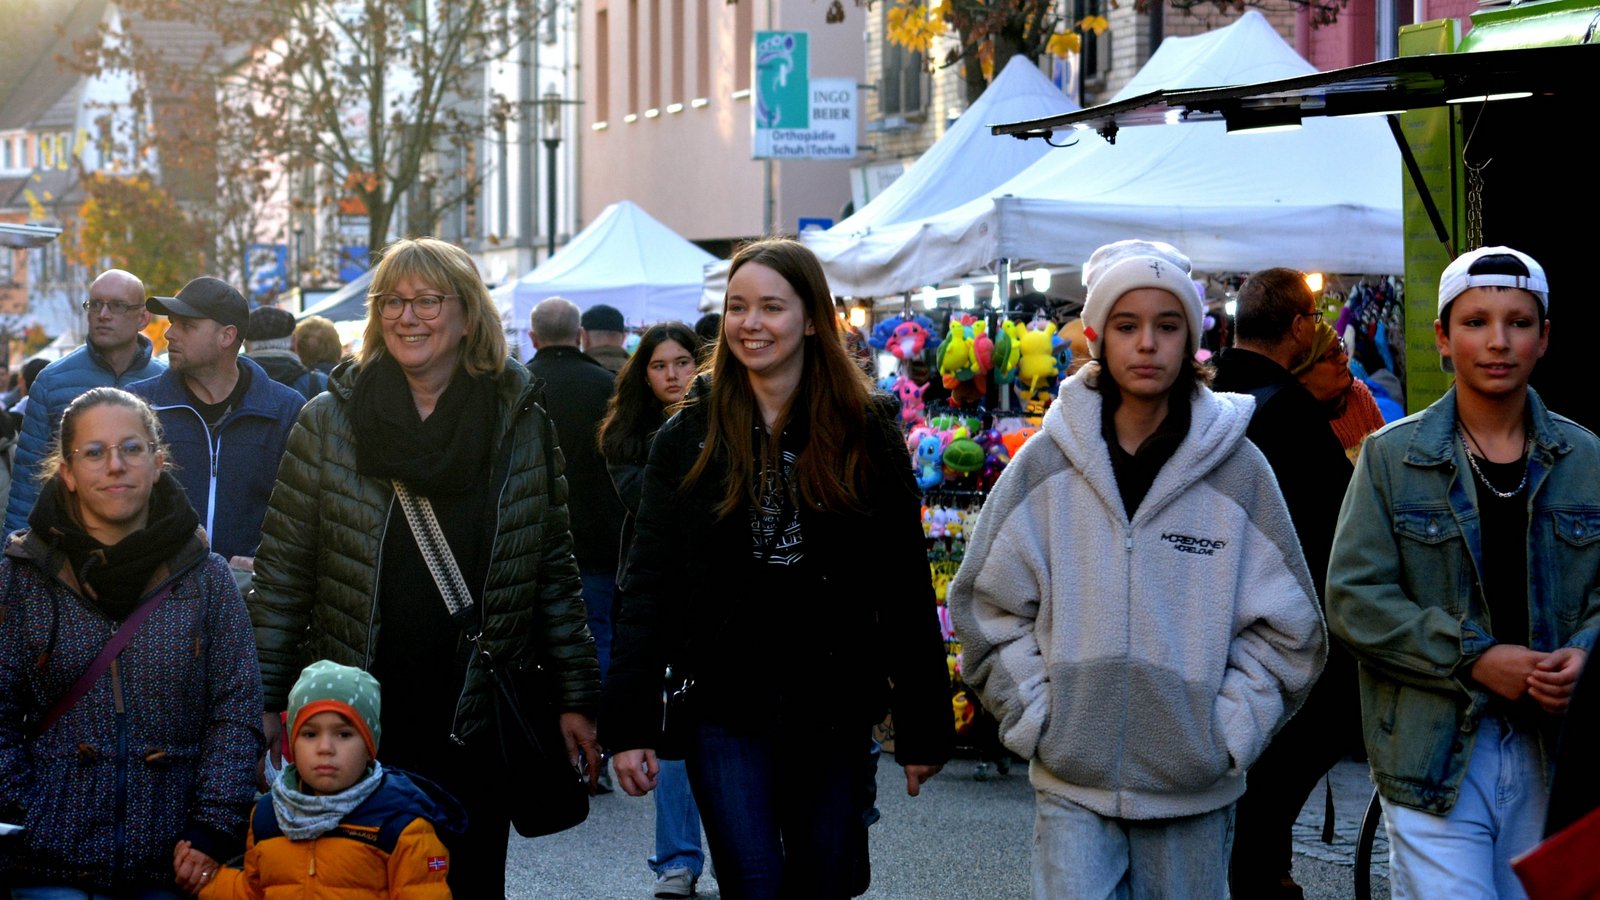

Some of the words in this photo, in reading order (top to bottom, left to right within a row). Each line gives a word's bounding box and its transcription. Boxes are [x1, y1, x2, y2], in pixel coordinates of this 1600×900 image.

[813, 90, 850, 103] INGO
[813, 108, 850, 120] BEIER
[772, 131, 836, 142] Orthopädie
[1161, 533, 1229, 549] MOREMONEY
[1174, 544, 1215, 556] MORELOVE
